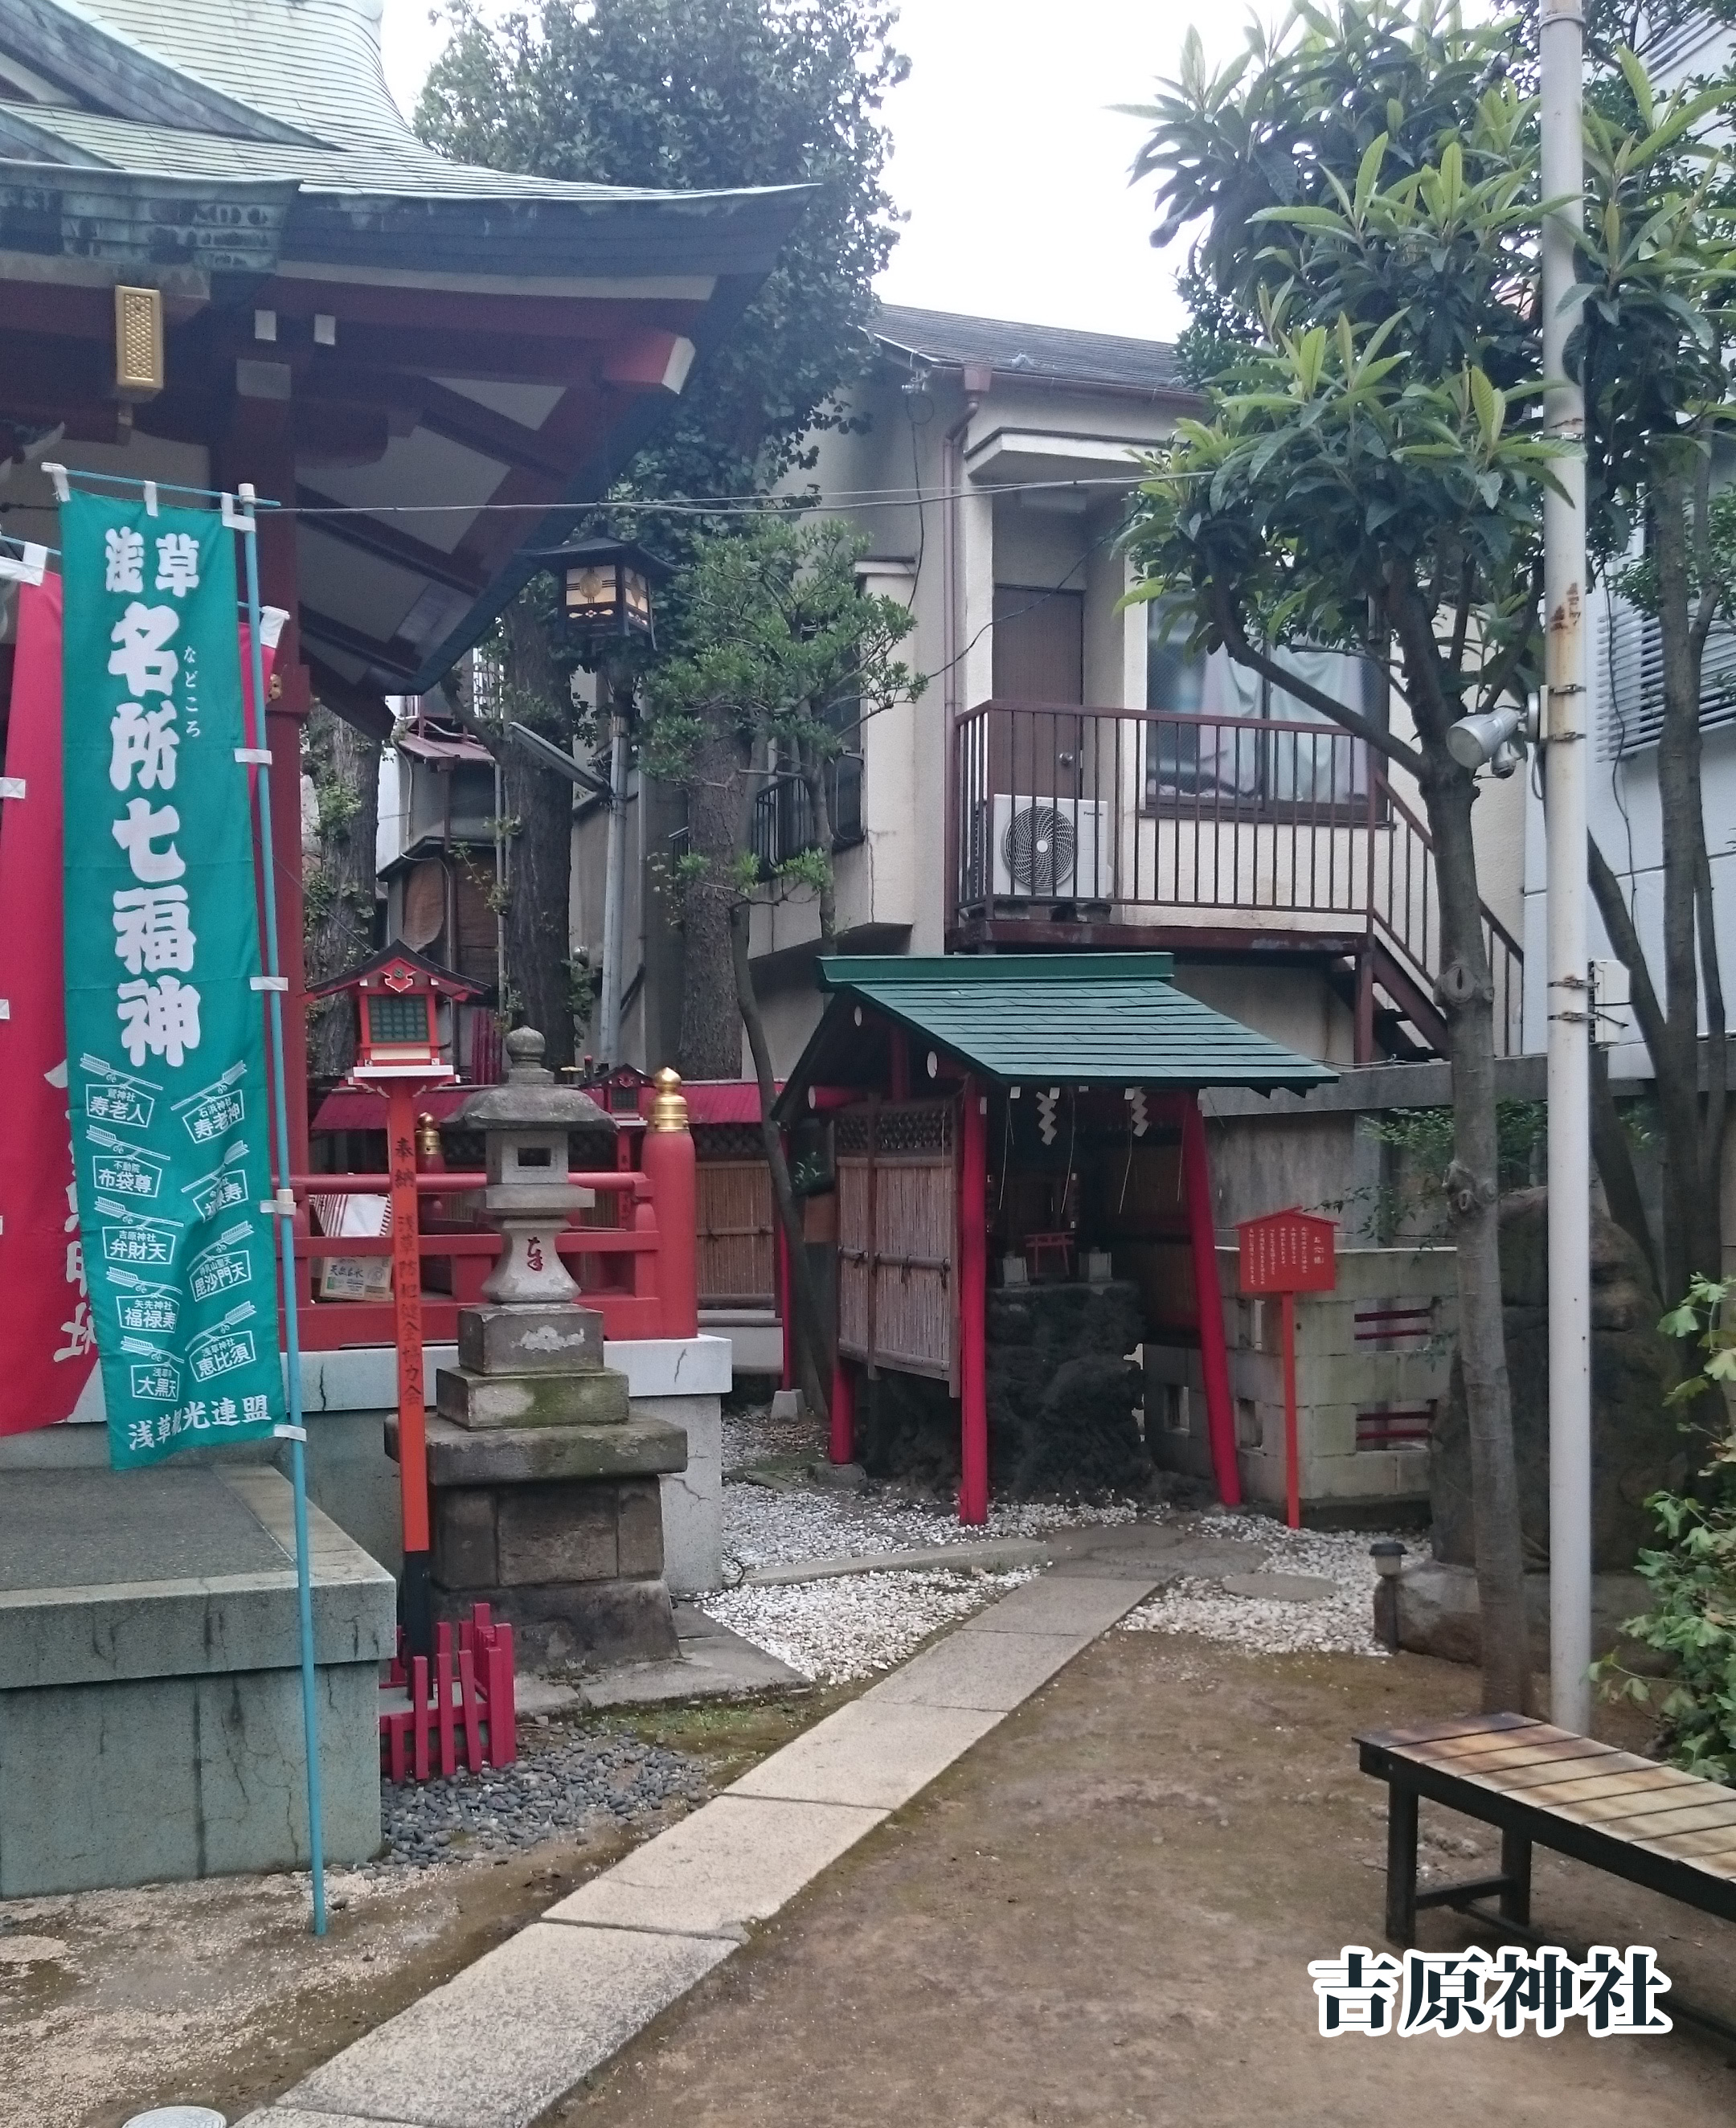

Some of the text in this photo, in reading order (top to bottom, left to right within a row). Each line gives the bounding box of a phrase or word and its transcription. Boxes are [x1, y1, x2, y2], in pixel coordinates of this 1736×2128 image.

[105, 526, 199, 597] 浅草
[183, 645, 200, 737] などころ
[108, 601, 201, 1067] 名所七福神
[89, 1096, 145, 1123] 寿老人
[194, 1102, 241, 1138] 寿老神
[395, 1136, 415, 1189] 奉納
[98, 1168, 153, 1193] 布袋尊
[109, 1238, 167, 1261] 弁財天
[119, 1230, 157, 1242] 吉原神社
[194, 1261, 248, 1298] 毘沙門天
[125, 1307, 176, 1330] 福禄寿
[134, 1299, 173, 1312] 矢先神社
[196, 1342, 252, 1378] 恵比須
[201, 1337, 236, 1359] 浅草神社
[136, 1376, 177, 1398] 大黒天
[128, 1394, 272, 1451] 浅草観光連盟
